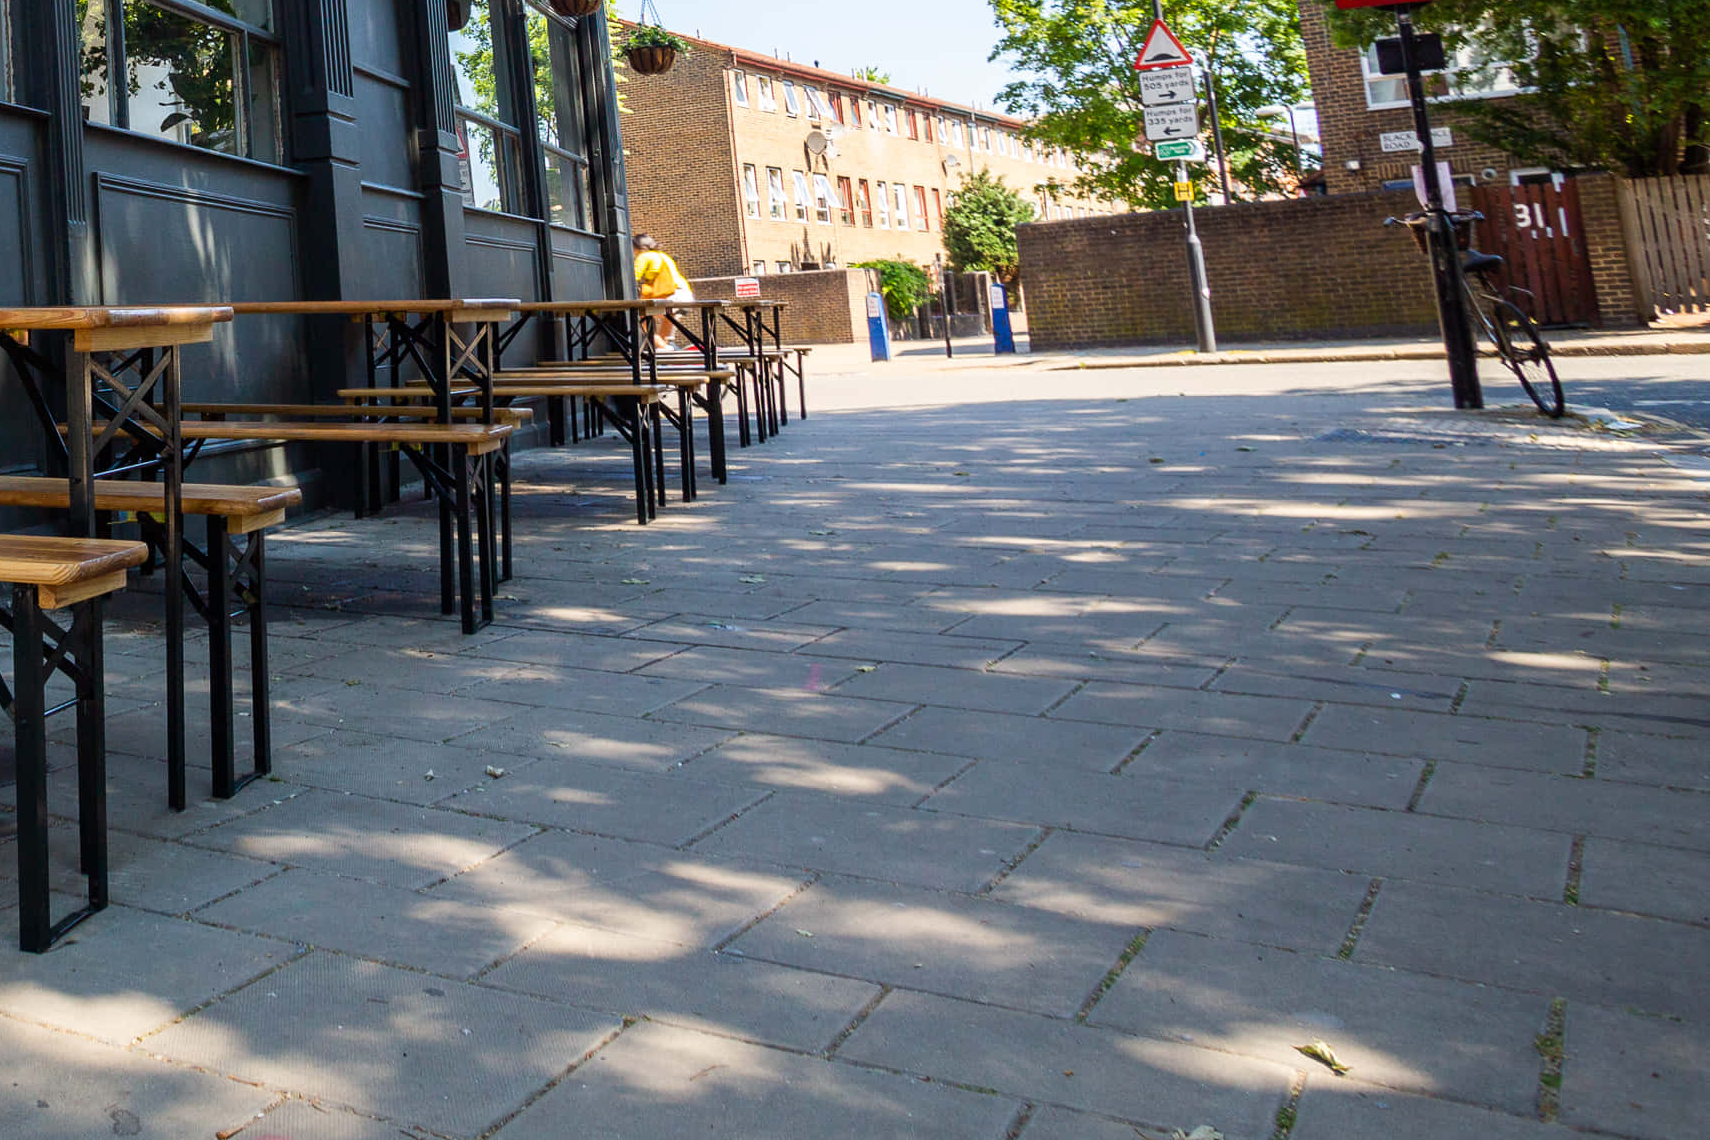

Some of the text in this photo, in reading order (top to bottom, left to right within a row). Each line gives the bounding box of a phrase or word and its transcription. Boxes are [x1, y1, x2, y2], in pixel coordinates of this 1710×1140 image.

[1141, 74, 1172, 82] Humps
[1165, 79, 1189, 89] yards
[1146, 109, 1176, 117] Humps
[1169, 116, 1193, 125] yards
[1383, 132, 1412, 141] BLACK
[1384, 141, 1411, 150] ROAD
